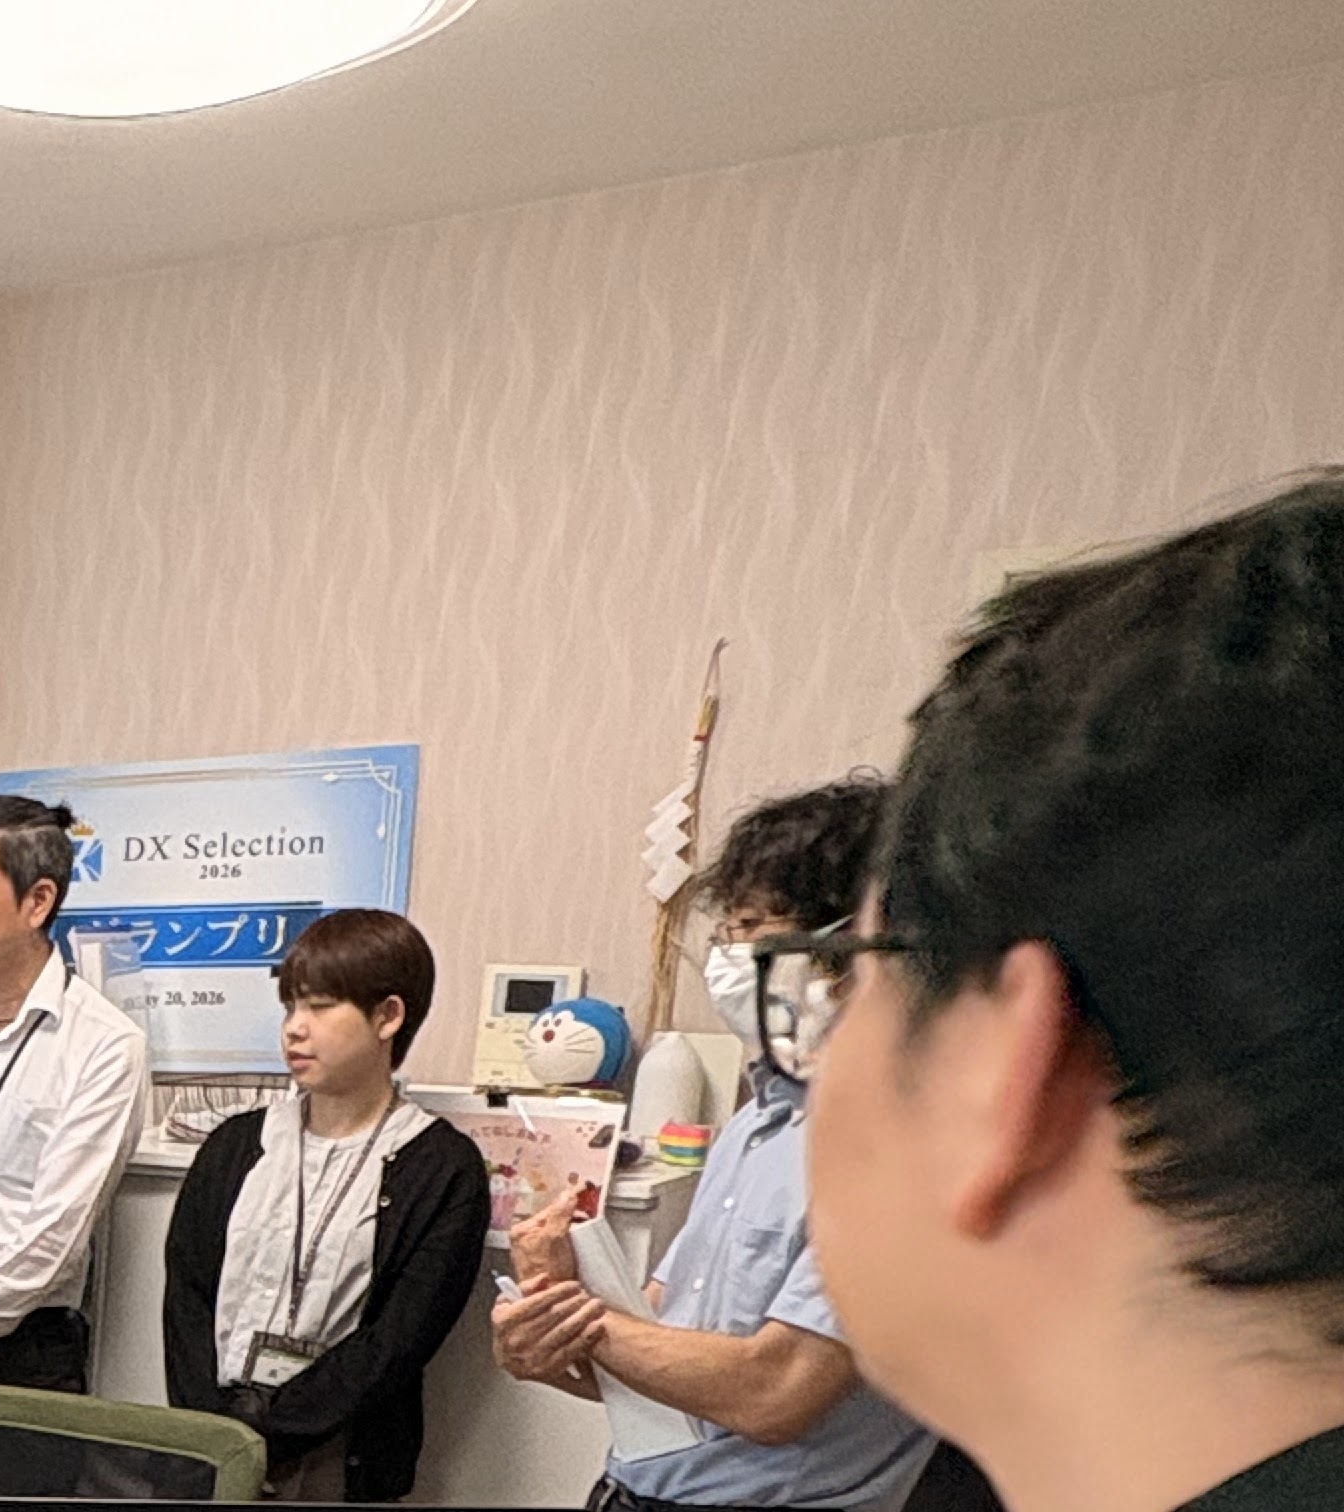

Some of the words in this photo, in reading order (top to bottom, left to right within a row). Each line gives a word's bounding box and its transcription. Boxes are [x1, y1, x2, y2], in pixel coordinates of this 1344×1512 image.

[123, 834, 172, 862] DX
[182, 826, 325, 860] Selection
[199, 863, 242, 880] 2026
[92, 912, 288, 956] ランプリ
[191, 990, 226, 1005] 2026
